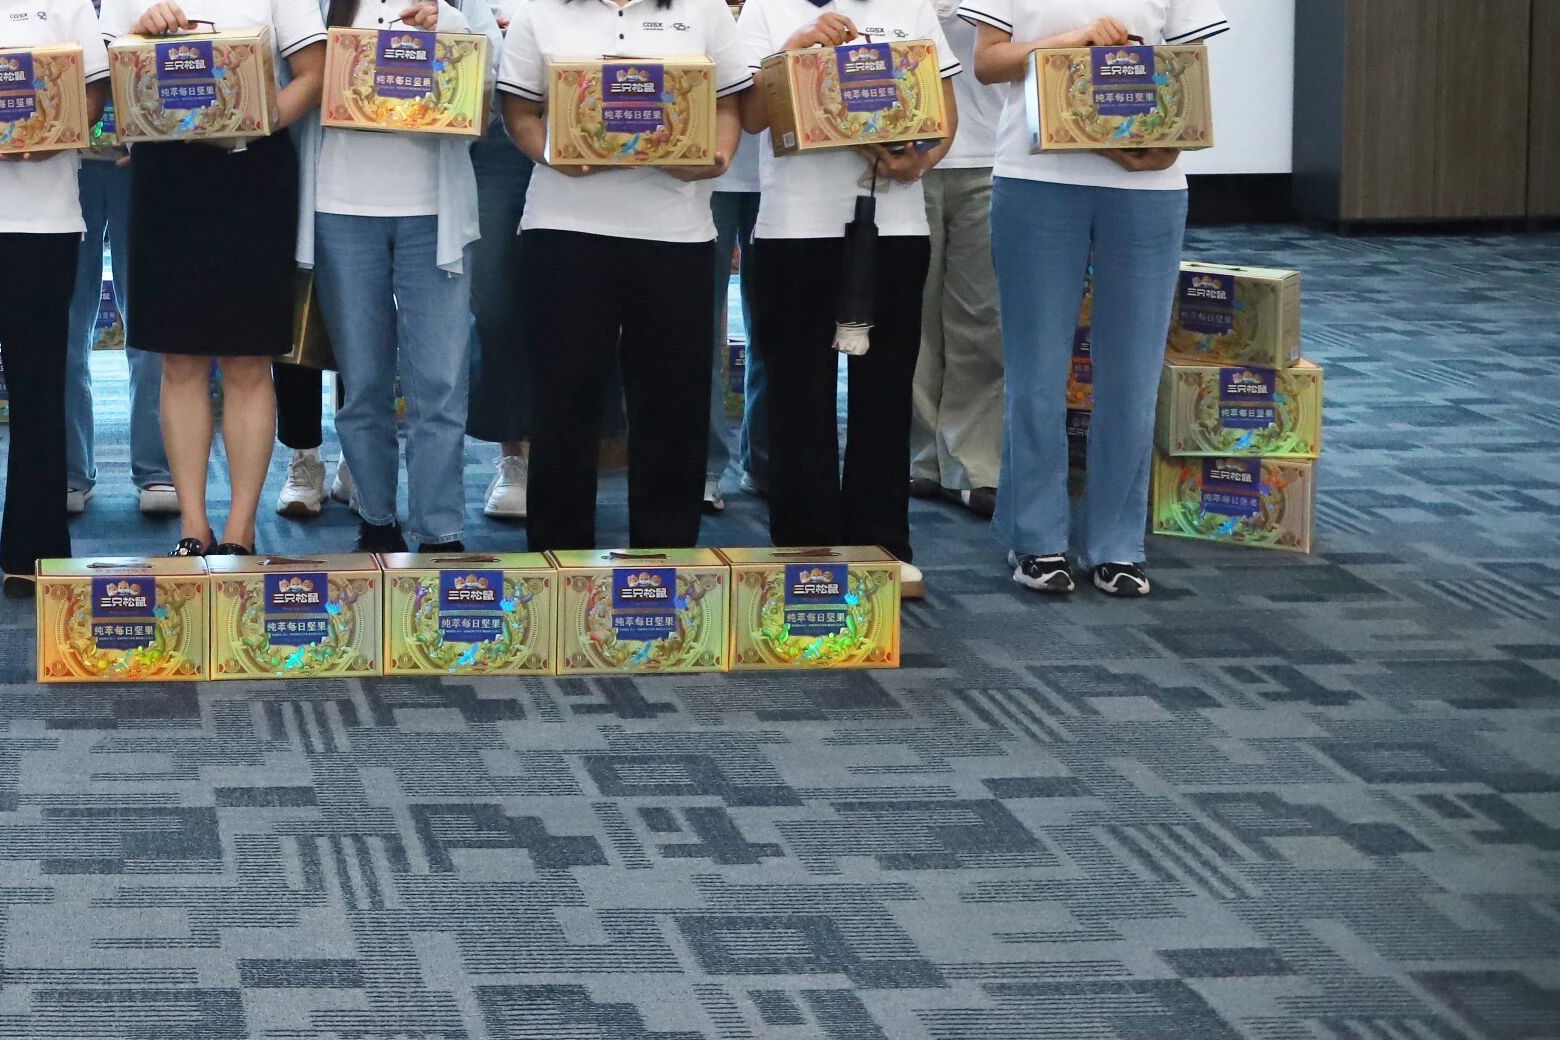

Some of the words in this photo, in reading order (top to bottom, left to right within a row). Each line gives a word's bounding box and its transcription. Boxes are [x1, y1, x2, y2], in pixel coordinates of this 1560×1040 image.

[384, 48, 427, 60] 三只松鼠
[164, 59, 207, 71] 三只松鼠
[845, 60, 886, 73] 三只松鼠
[1100, 64, 1146, 76] 三只松鼠
[376, 75, 431, 87] 纯萃每日坚果
[160, 85, 215, 97] 纯萃每日坚果
[610, 82, 655, 93] 三只松鼠
[843, 87, 896, 100] 纯萃每日坚果
[1095, 92, 1155, 103] 纯萃每日坚果
[604, 109, 662, 121] 纯萃每日坚果
[1187, 288, 1227, 300] 三只松鼠
[1227, 384, 1268, 394] 三只松鼠
[1210, 469, 1253, 483] 三只松鼠
[621, 588, 668, 598] 三只松鼠
[793, 584, 840, 594] 三只松鼠
[273, 592, 320, 603] 三只松鼠
[447, 590, 495, 601] 三只松鼠
[100, 596, 147, 607] 三只松鼠
[615, 616, 674, 627] 纯萃每日坚果
[786, 612, 845, 623] 纯萃每日坚果
[266, 621, 327, 632] 纯萃每日坚果
[441, 618, 501, 629] 纯萃每日坚果
[94, 625, 154, 636] 纯萃每日坚果
